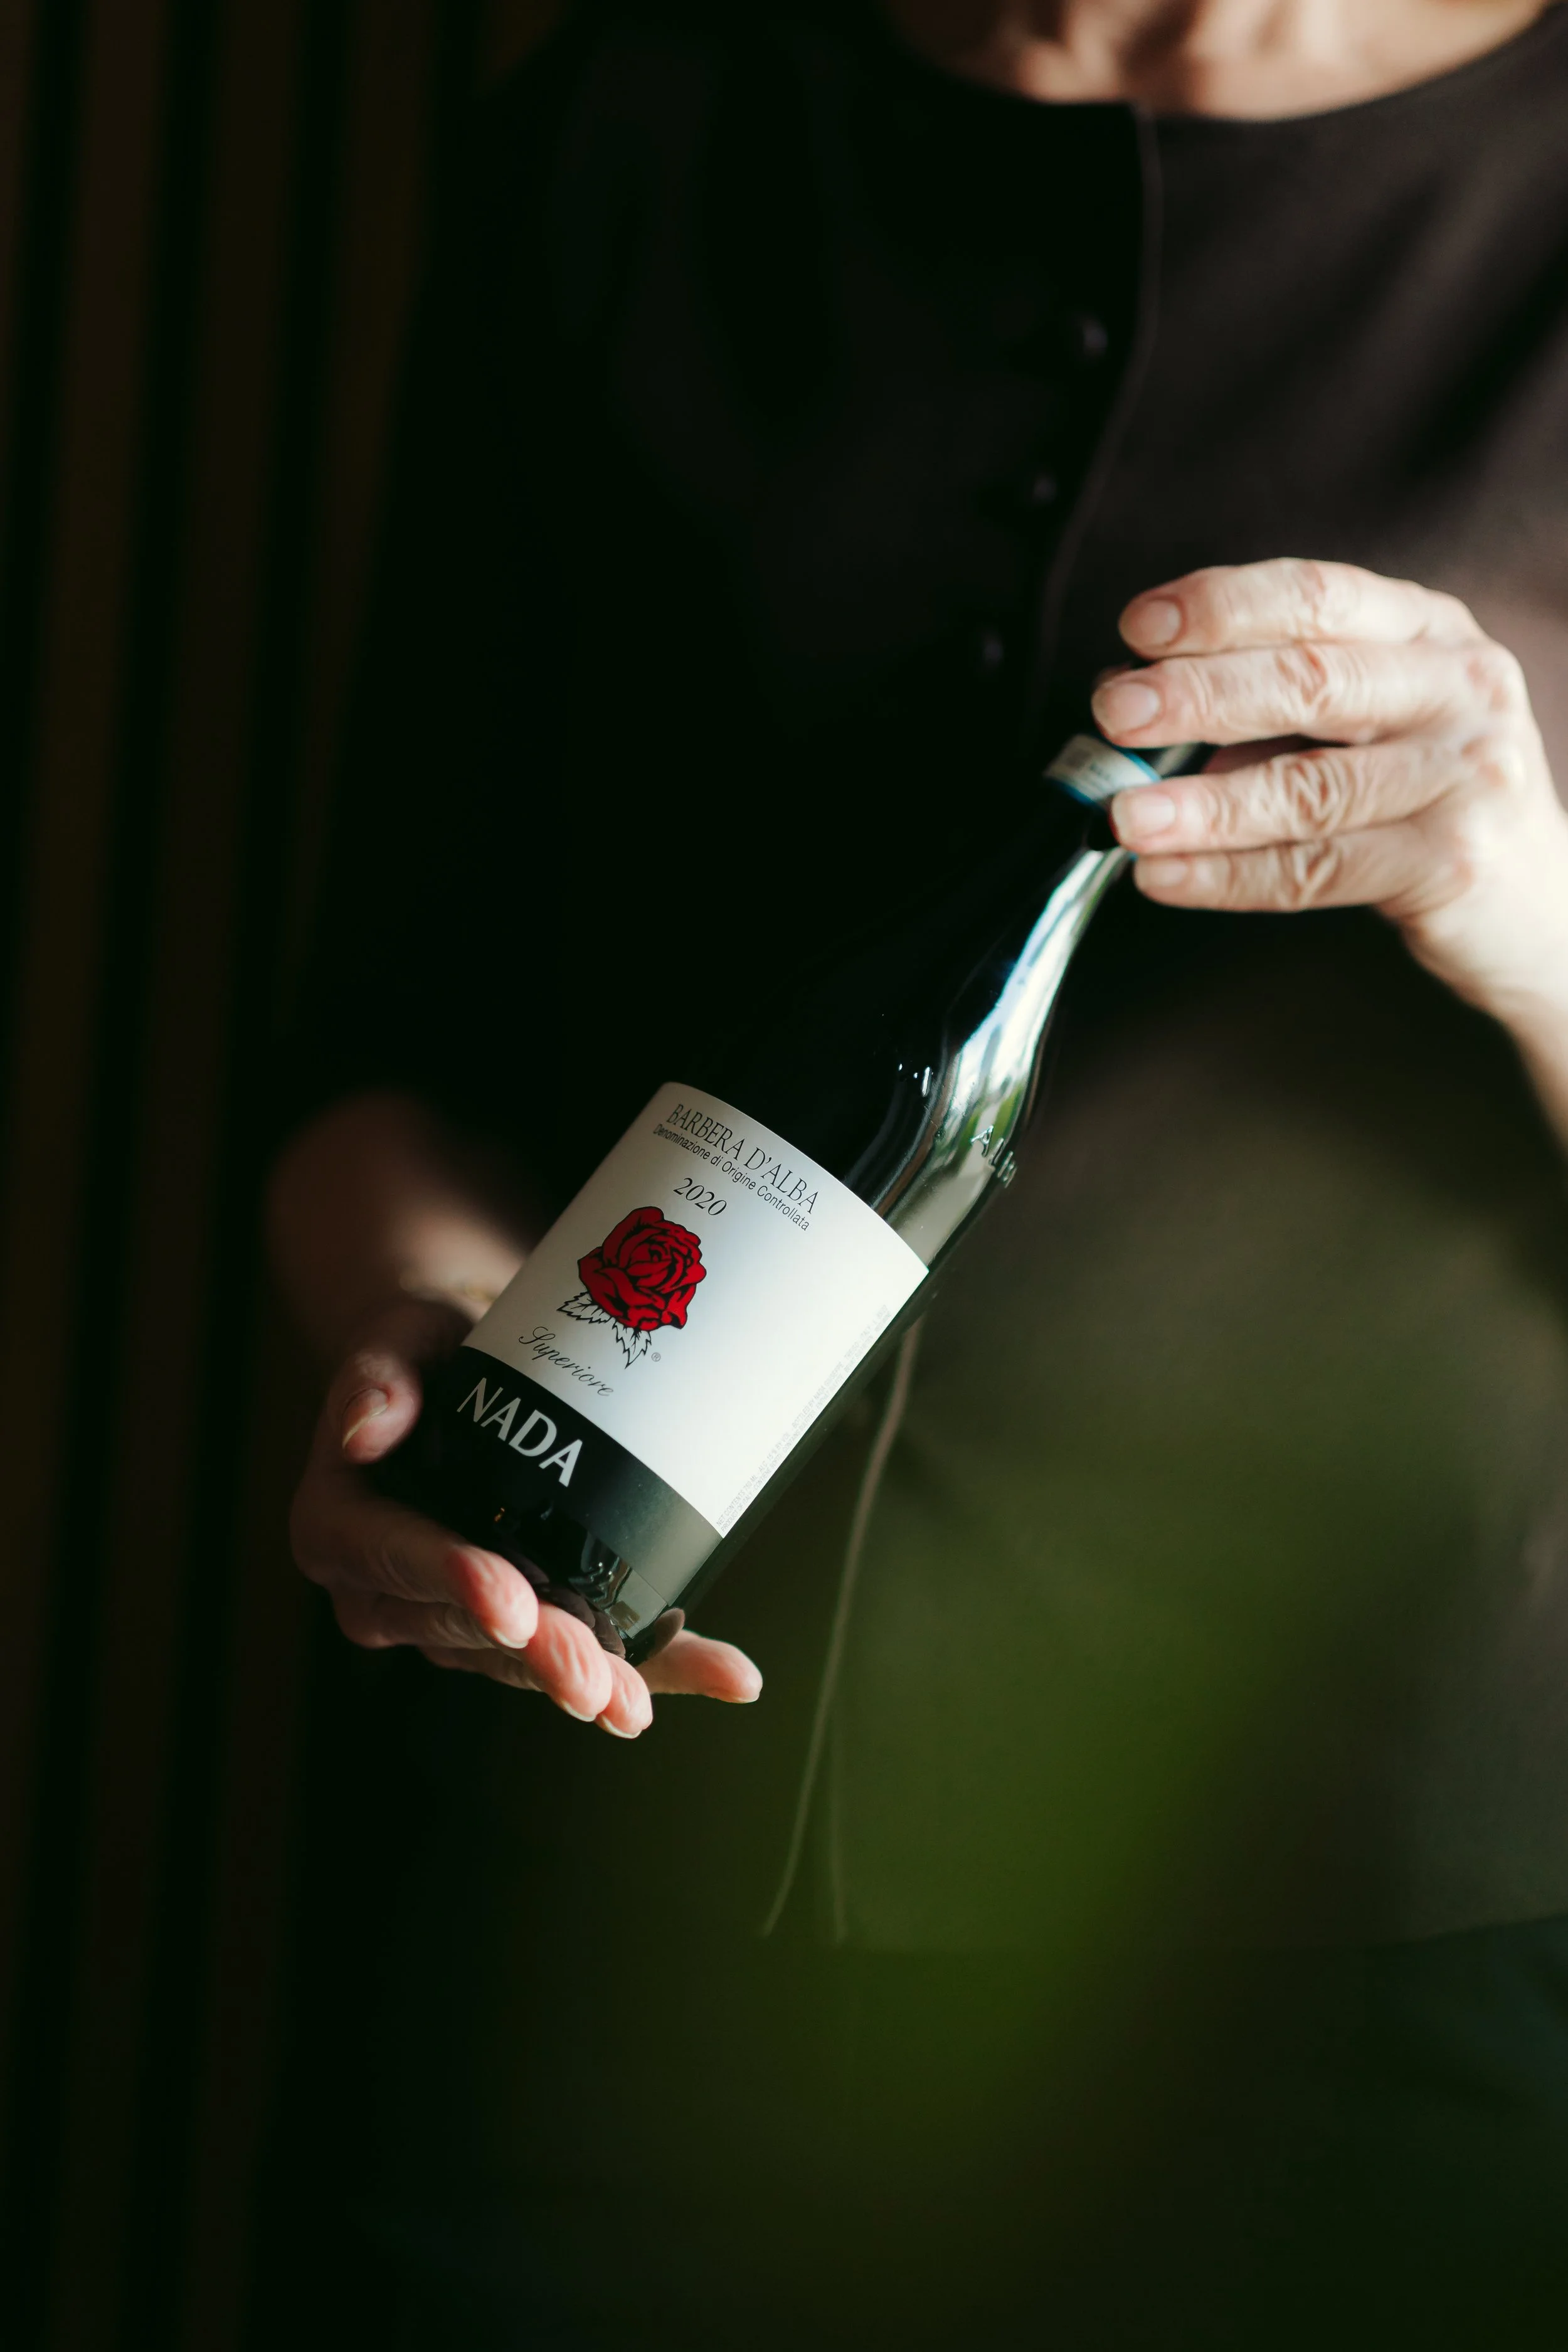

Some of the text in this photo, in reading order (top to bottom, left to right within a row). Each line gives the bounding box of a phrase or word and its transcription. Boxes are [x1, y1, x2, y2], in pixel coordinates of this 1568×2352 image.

[666, 1104, 746, 1161] BARBERA
[653, 1123, 810, 1231] Denominazione di Origine Controllata
[673, 1177, 728, 1216] 2020
[518, 1326, 614, 1397] Superiore
[457, 1377, 583, 1488] NADA
[724, 1490, 744, 1516] CONTENTS
[792, 1406, 810, 1428] BOTTLED
[721, 1510, 738, 1532] PRODUCT
